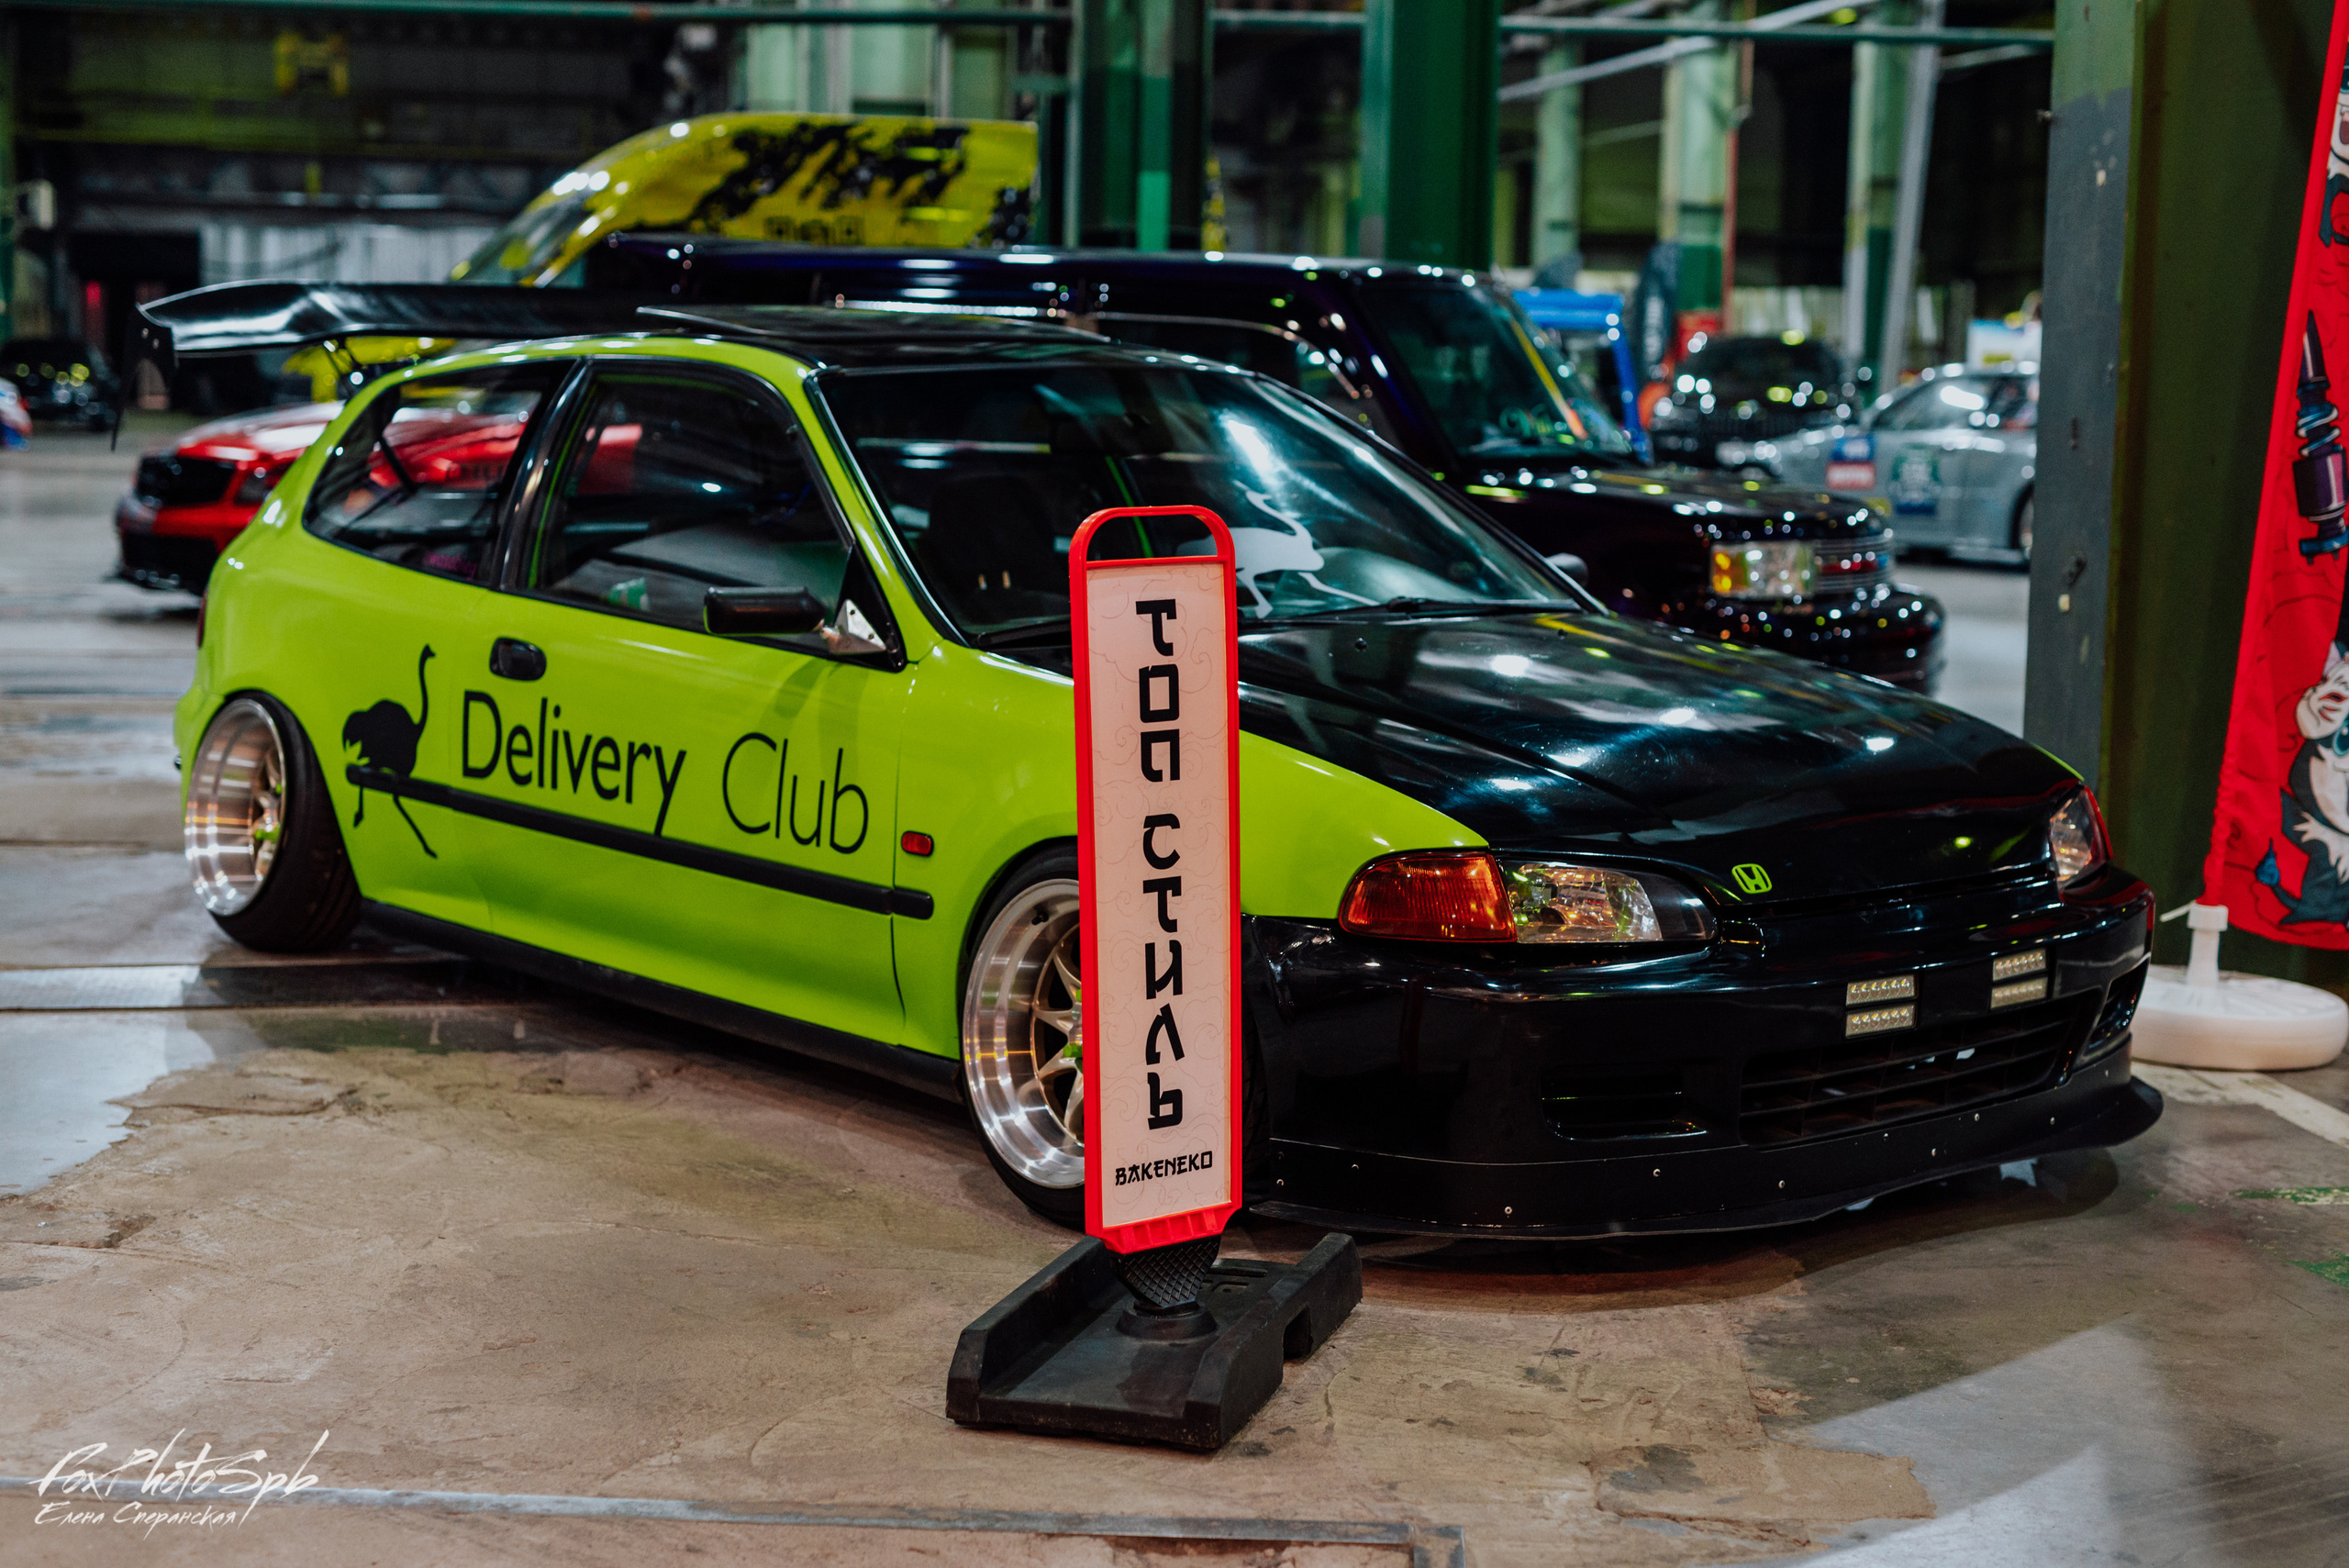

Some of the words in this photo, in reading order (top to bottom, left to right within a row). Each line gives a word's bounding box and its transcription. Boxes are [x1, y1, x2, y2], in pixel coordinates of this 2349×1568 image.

[462, 689, 687, 837] Delivery
[721, 731, 869, 855] Club
[1135, 598, 1181, 783] ТОП
[1142, 813, 1186, 1130] СТИЛЬ
[1115, 1150, 1214, 1186] BAKENEKO
